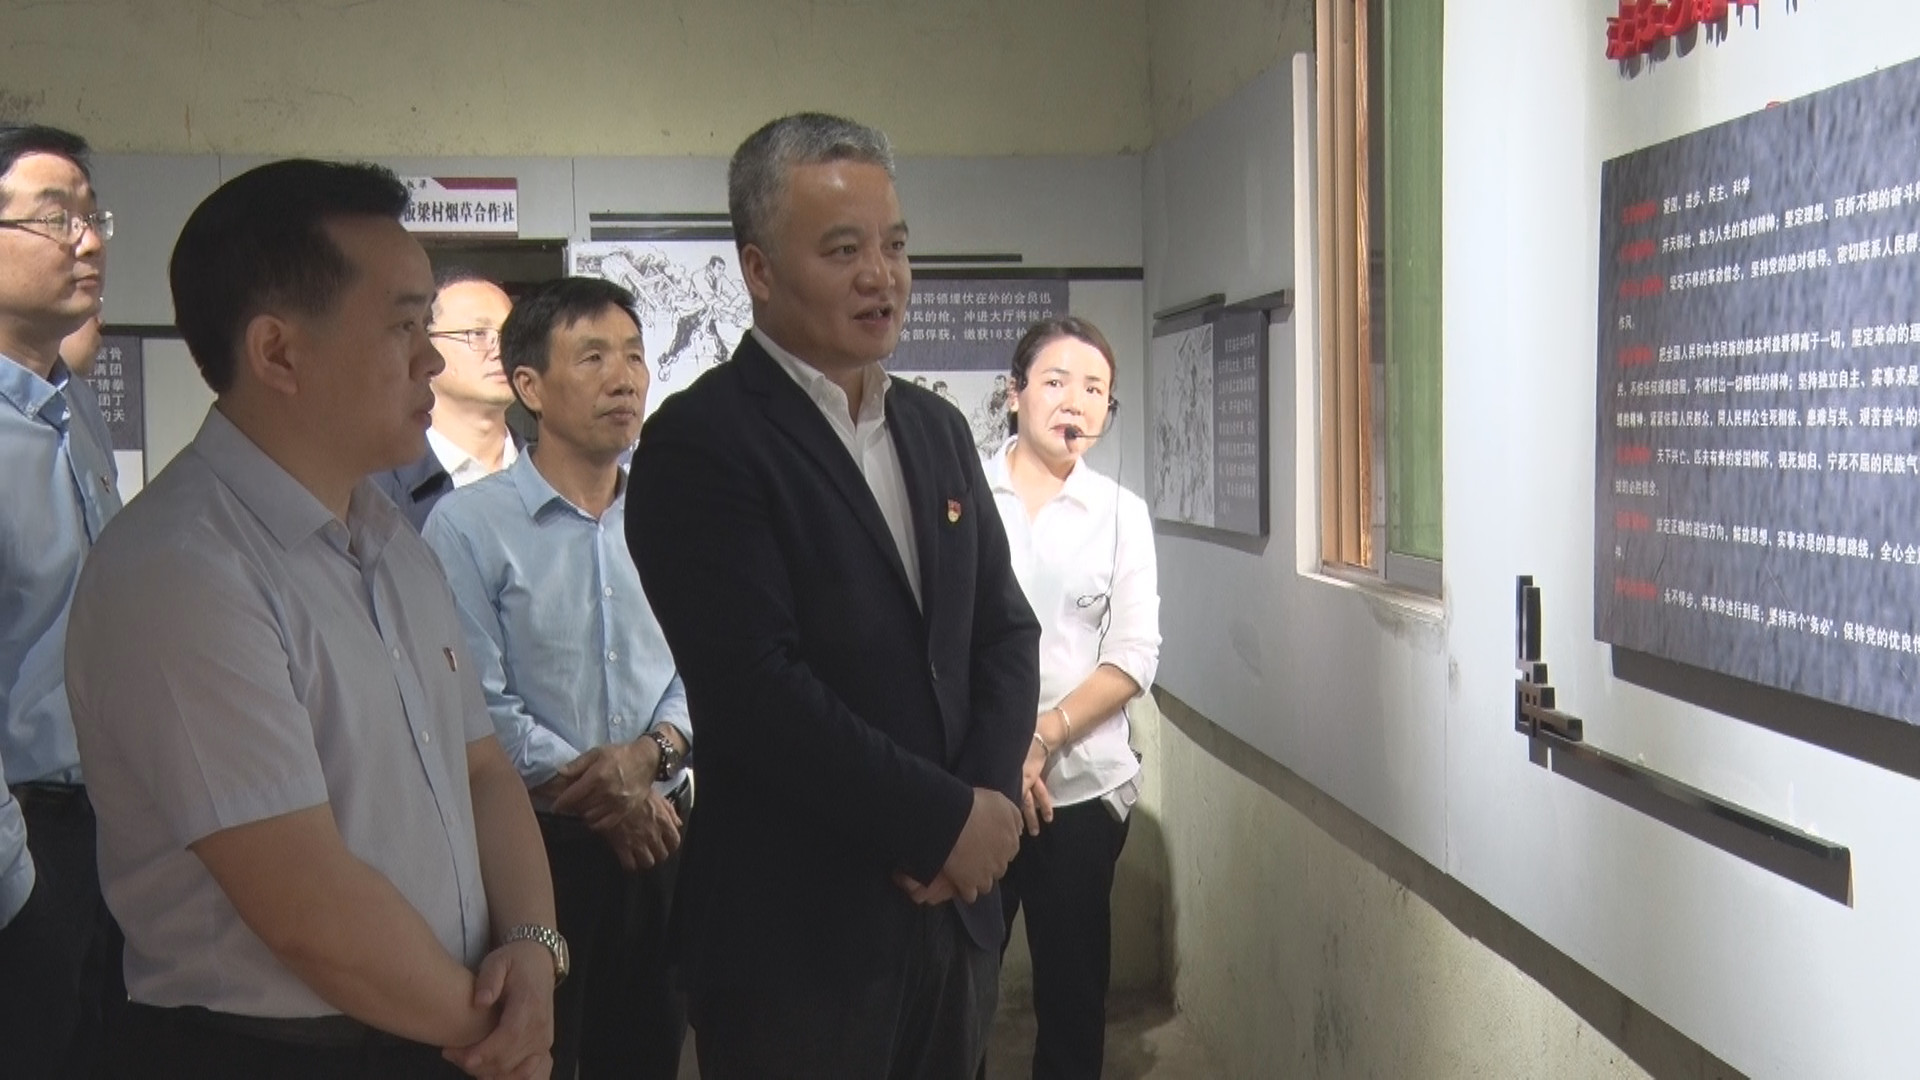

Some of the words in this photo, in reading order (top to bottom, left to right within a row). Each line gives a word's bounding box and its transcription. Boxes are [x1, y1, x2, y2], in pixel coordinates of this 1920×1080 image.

[1669, 232, 1920, 291] 坚定不移的革命信念，坚持党的绝对领导。密切联系人民群
[1656, 518, 1920, 565] 坚定正确的政治方向，解放思想、实事求是的思想路线，全心全
